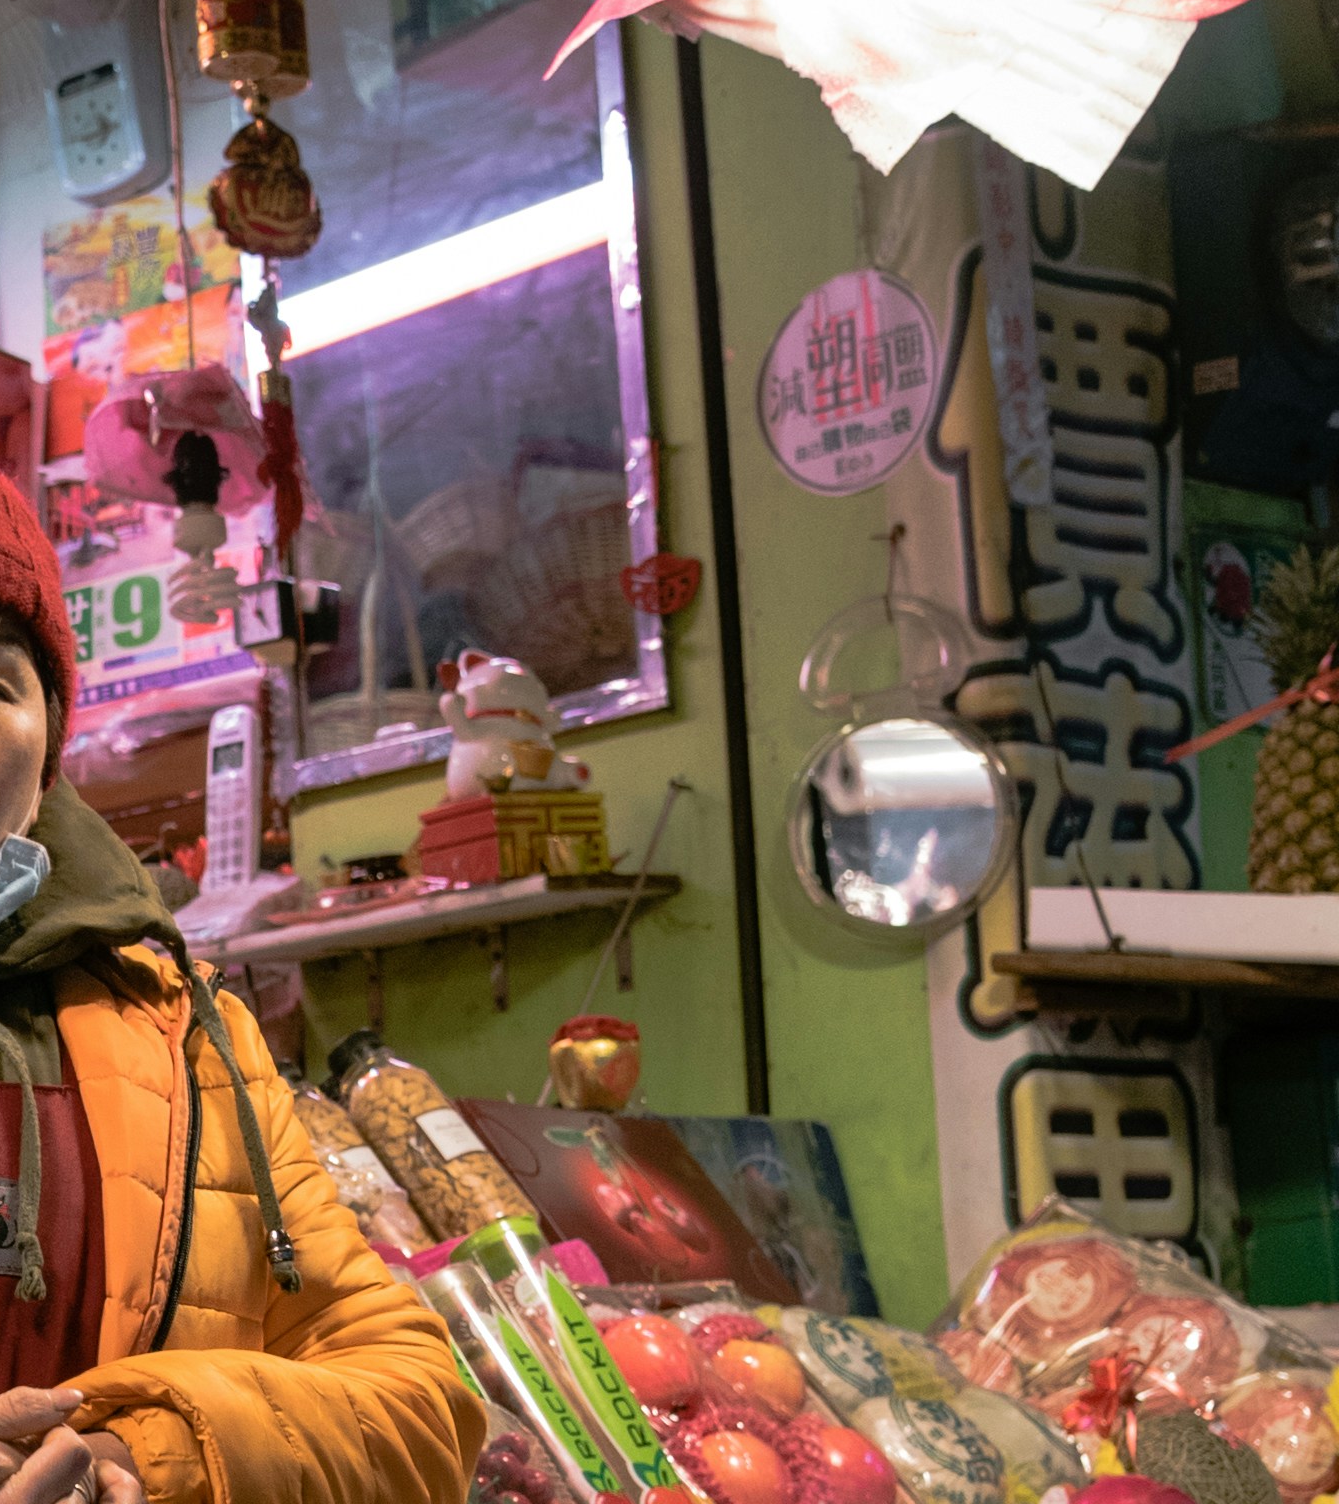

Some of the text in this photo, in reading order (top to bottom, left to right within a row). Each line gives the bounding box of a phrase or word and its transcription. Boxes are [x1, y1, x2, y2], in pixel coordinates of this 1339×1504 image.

[112, 575, 162, 647] 9
[513, 1344, 598, 1462] ROCKIT
[562, 1316, 653, 1449] ROCKIT
